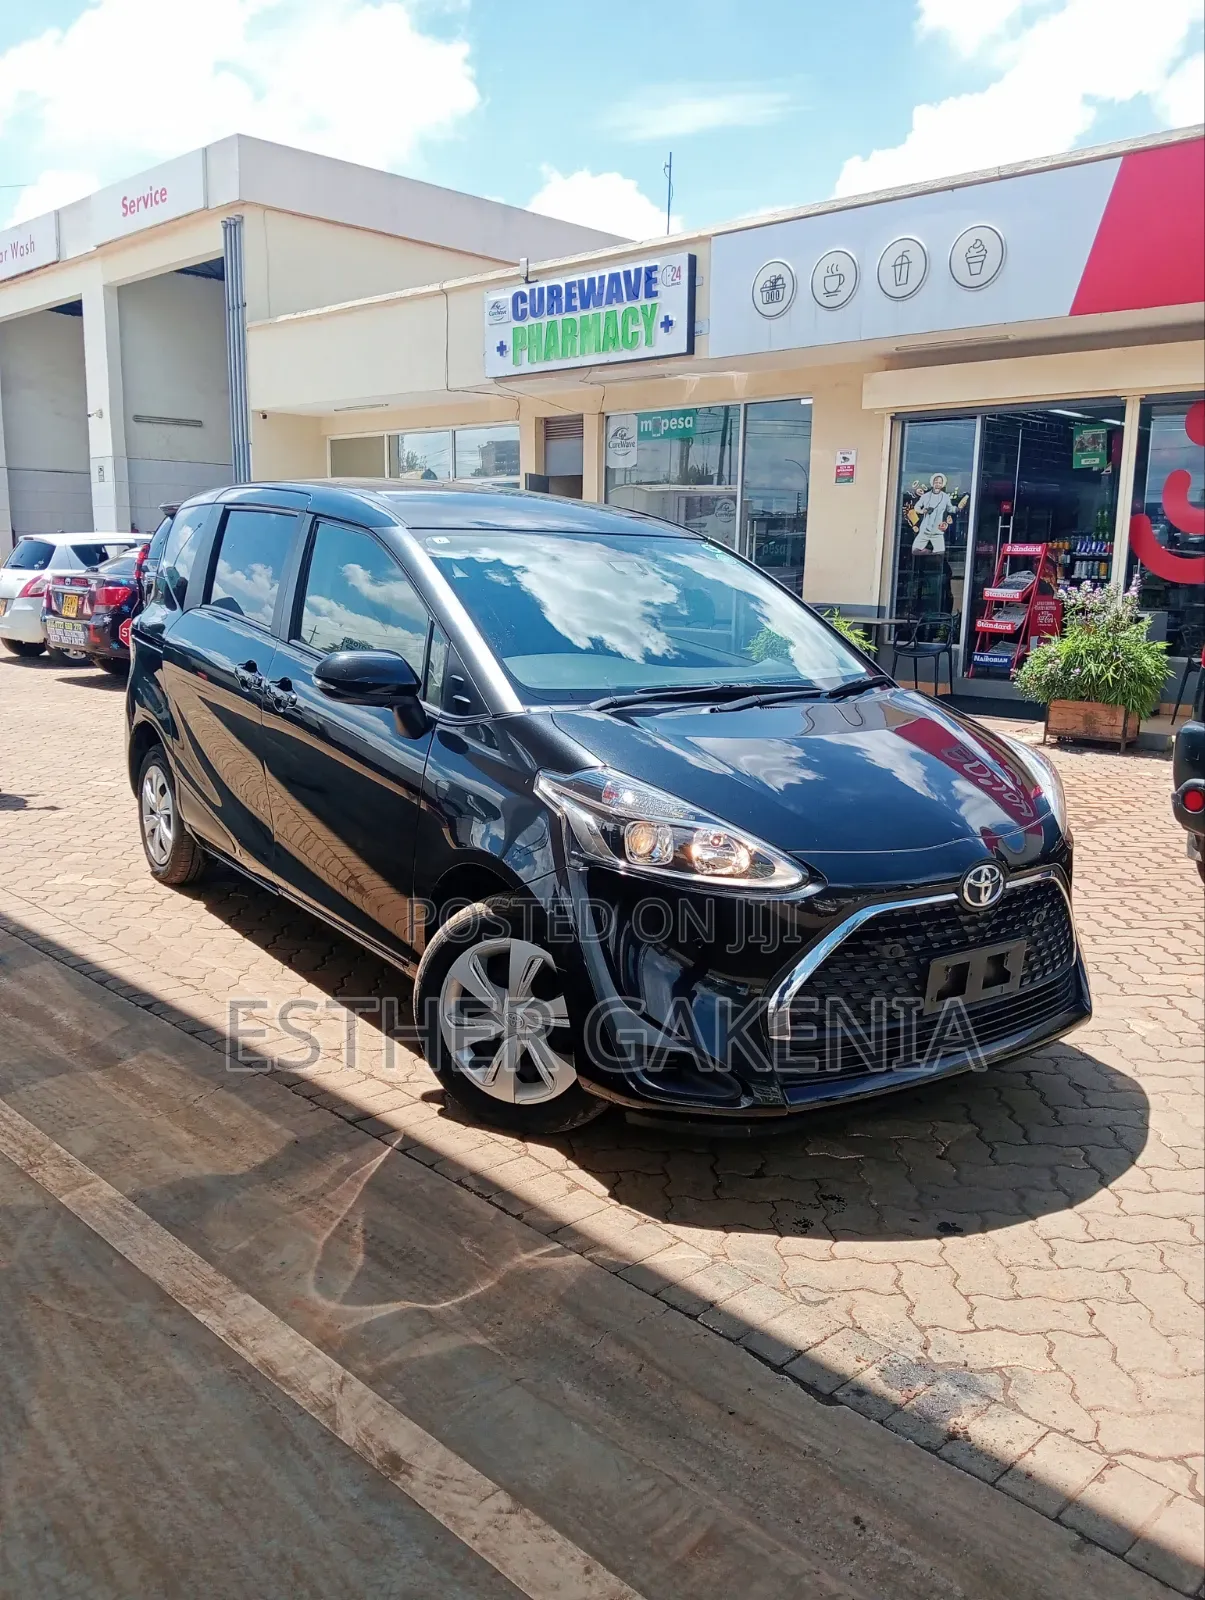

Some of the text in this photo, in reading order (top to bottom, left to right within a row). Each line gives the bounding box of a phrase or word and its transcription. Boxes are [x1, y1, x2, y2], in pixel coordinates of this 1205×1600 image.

[121, 185, 168, 217] Service
[0, 234, 35, 263] ar Wash
[671, 265, 682, 282] 24
[511, 264, 659, 322] CUREWAVE
[512, 302, 658, 367] PHARMACY
[984, 590, 1020, 599] Standard
[977, 620, 1012, 630] Standard
